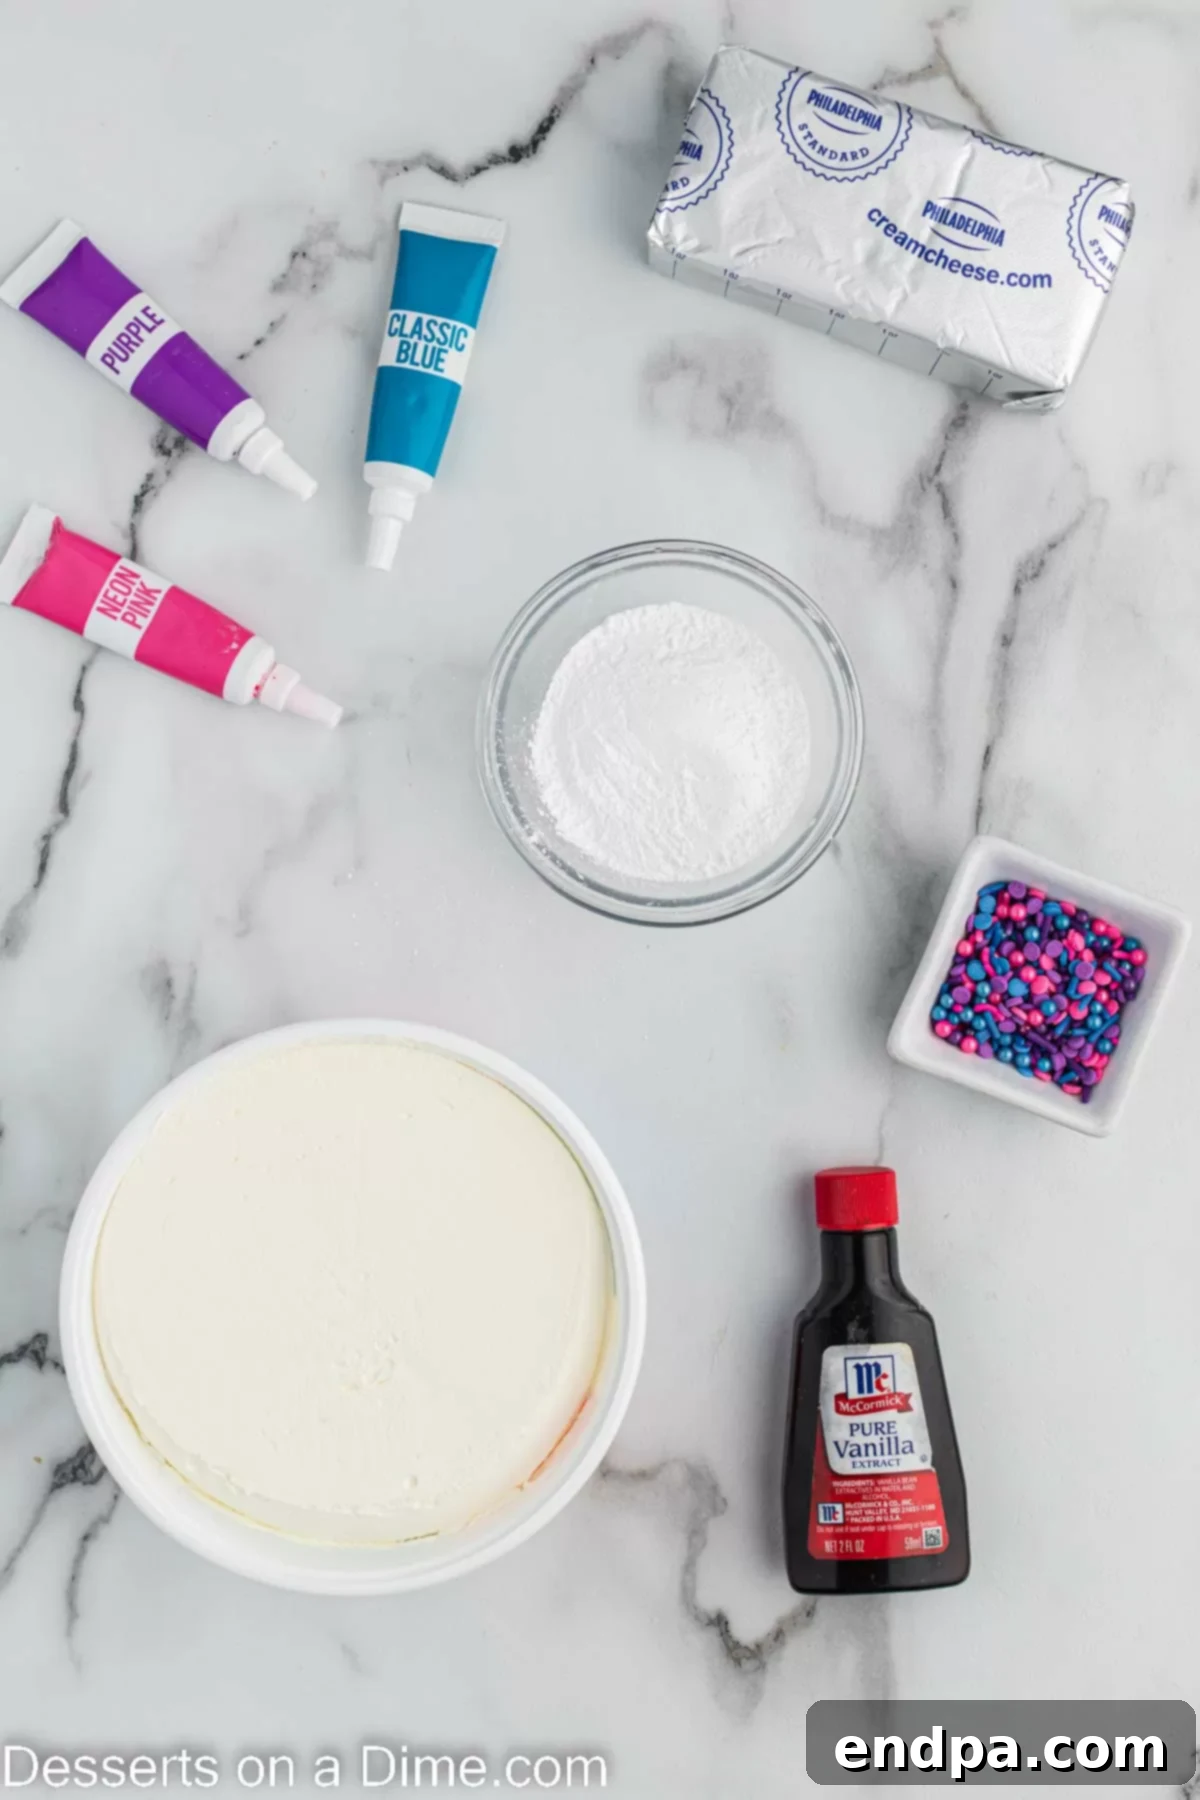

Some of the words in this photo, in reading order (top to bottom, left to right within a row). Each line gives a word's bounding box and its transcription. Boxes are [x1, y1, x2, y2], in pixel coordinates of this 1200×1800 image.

[806, 89, 884, 131] PHILADELPHIA
[798, 123, 870, 162] STANDARD
[922, 200, 1006, 247] PHILADELPHIA
[867, 208, 1052, 288] creamcheese.com
[100, 305, 165, 375] PURPLE
[388, 312, 468, 352] CLASSIC
[395, 340, 448, 373] BLUE
[95, 565, 141, 621] NEON
[120, 580, 162, 630] PINK
[837, 1395, 903, 1413] McCormick
[832, 1436, 915, 1459] Vanilla
[848, 1420, 898, 1437] PURE
[851, 1458, 901, 1469] EXTRACT
[824, 1540, 838, 1553] NET
[839, 1540, 844, 1552] 2
[854, 1540, 865, 1552] OZ
